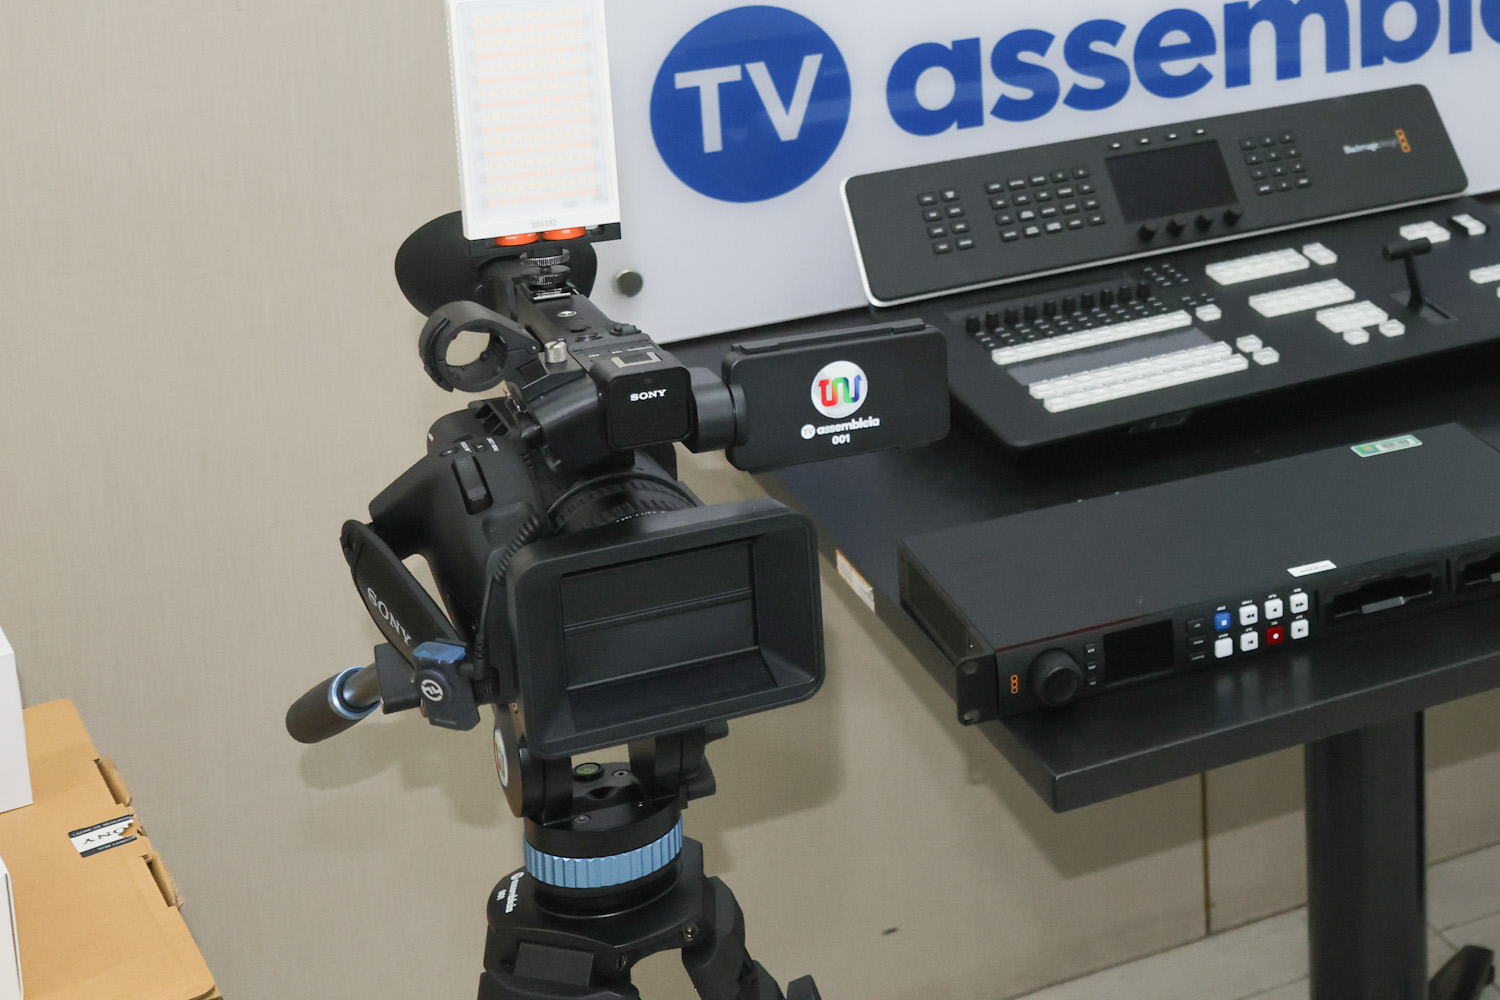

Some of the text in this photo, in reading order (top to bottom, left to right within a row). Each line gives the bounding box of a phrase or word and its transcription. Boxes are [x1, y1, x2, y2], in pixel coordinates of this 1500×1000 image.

[674, 53, 823, 154] TV
[630, 388, 667, 402] SONY
[816, 416, 880, 435] assembleia
[831, 433, 851, 445] 001
[367, 586, 412, 646] SONY
